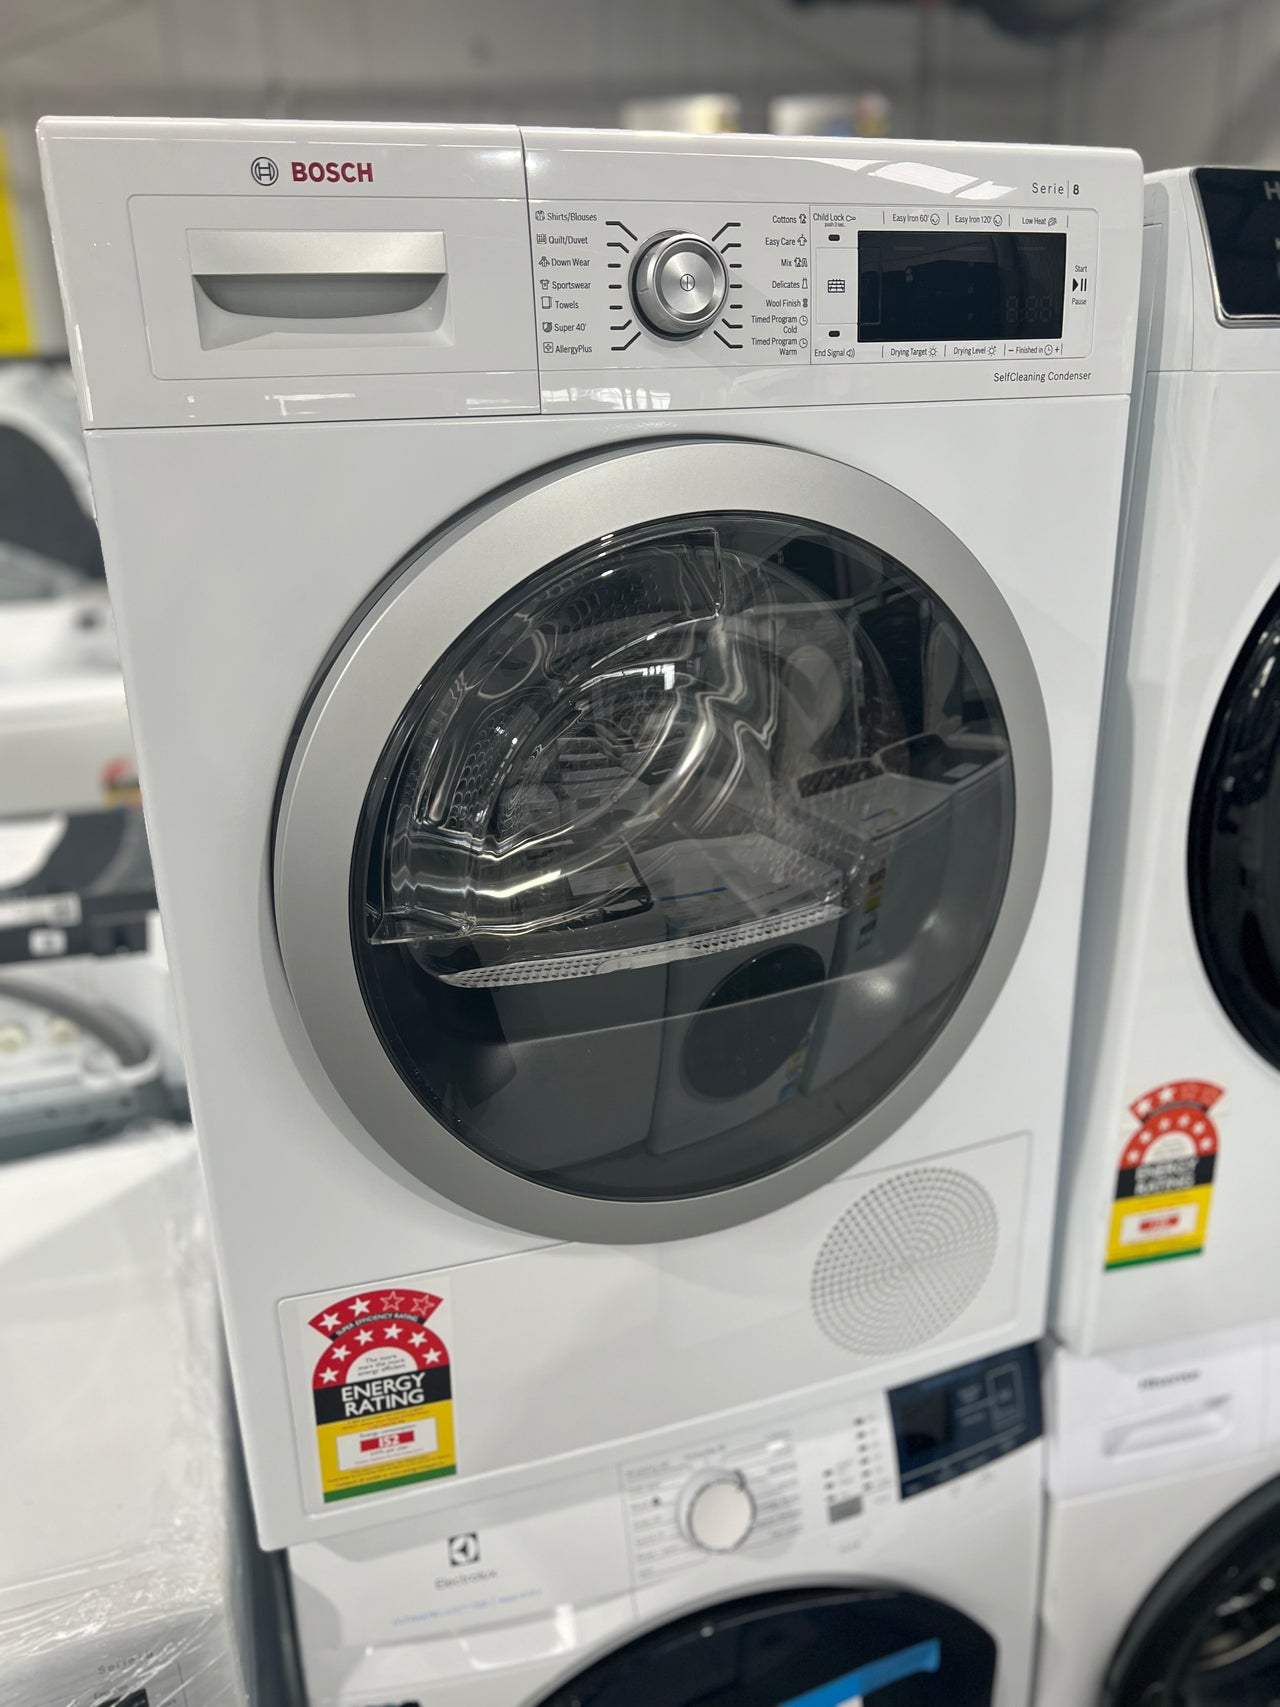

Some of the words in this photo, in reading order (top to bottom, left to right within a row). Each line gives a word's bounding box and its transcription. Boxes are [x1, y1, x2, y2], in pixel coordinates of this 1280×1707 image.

[291, 161, 374, 183] BOSCH
[1031, 182, 1064, 195] Serie
[1072, 184, 1080, 195] 8
[547, 212, 597, 222] Shirts/Blouses
[772, 215, 797, 224] Cottons
[813, 212, 829, 221] Child
[830, 213, 844, 221] Lock
[892, 214, 906, 223] Easy
[907, 214, 918, 222] Iron
[955, 215, 967, 224] Easy
[968, 215, 980, 223] Iron
[1021, 217, 1033, 225] Low
[1033, 217, 1046, 225] Heat
[548, 236, 588, 245] Quilt/Duvet
[765, 237, 780, 246] Easy
[781, 237, 796, 246] Care
[551, 258, 572, 267] Down
[572, 258, 590, 266] Wear
[781, 258, 792, 267] Mix
[1074, 264, 1088, 273] Start
[551, 281, 591, 291] Sportswear
[772, 280, 800, 289] Delicates
[555, 301, 579, 309] Towels
[765, 299, 782, 307] Wool
[782, 299, 801, 307] Finish
[1071, 297, 1087, 306] Pause
[751, 315, 771, 324] Timed
[771, 315, 797, 325] Program
[554, 323, 575, 332] Super
[783, 325, 797, 334] Cold
[752, 338, 771, 346] Timed
[771, 337, 797, 347] Program
[555, 345, 592, 355] AllergyPlus
[779, 348, 797, 356] Warm
[814, 349, 826, 357] End
[826, 349, 845, 358] Signal
[890, 348, 909, 357] Drying
[910, 348, 927, 356] Target
[953, 347, 969, 356] Drying
[970, 346, 986, 355] Level
[1015, 346, 1037, 354] Finished
[993, 372, 1046, 383] SelfCleaning
[1047, 371, 1091, 381] Condenser
[341, 1372, 426, 1402] ENERGY
[345, 1388, 425, 1417] RATING
